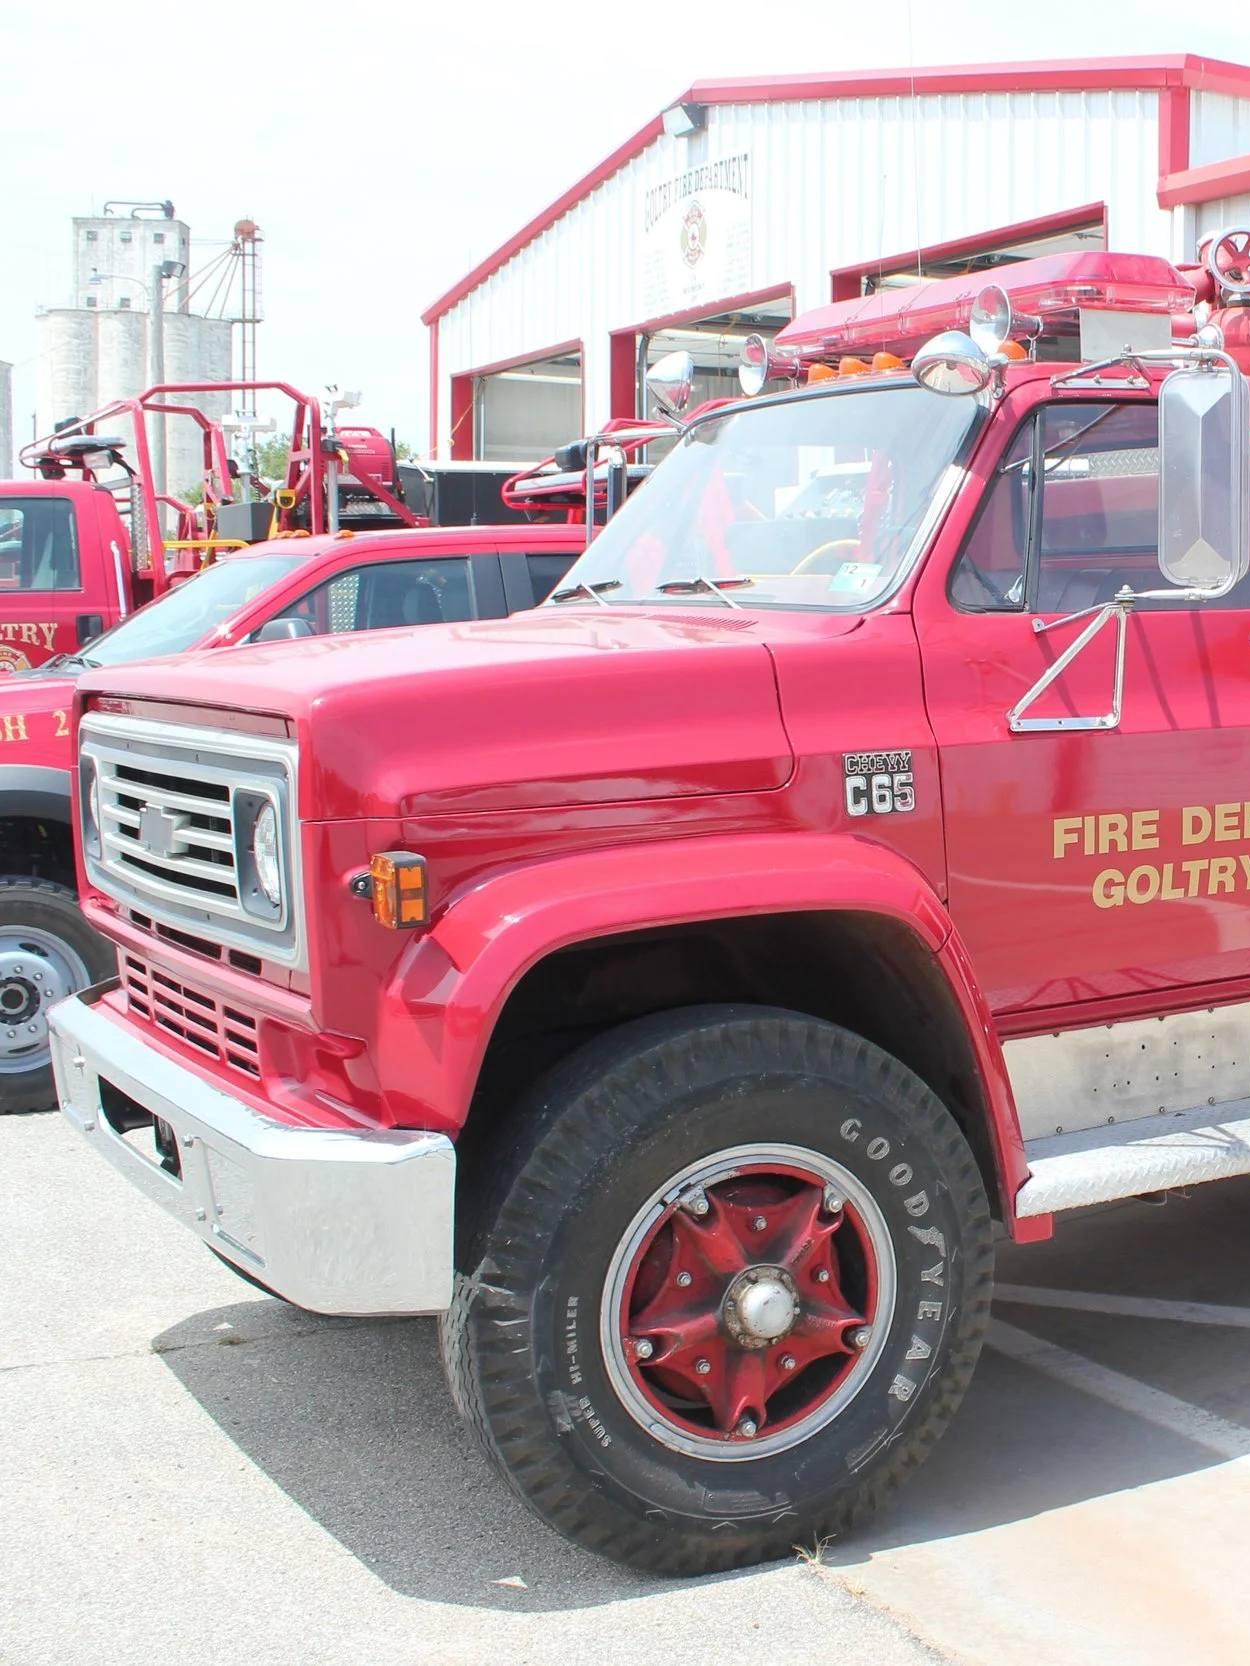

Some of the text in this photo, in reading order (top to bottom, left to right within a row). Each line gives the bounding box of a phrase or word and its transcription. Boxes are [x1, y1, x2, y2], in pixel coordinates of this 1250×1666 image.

[645, 153, 749, 234] GOLTRY FIRE DEPARTMENT
[0, 622, 58, 652] TRY
[0, 710, 70, 742] H 2
[844, 750, 912, 775] CHEVY
[845, 772, 916, 816] C65
[1053, 810, 1160, 859] FIRE
[839, 1117, 945, 1403] GOODYEAR
[565, 1295, 612, 1448] SUPER HI-MILER
